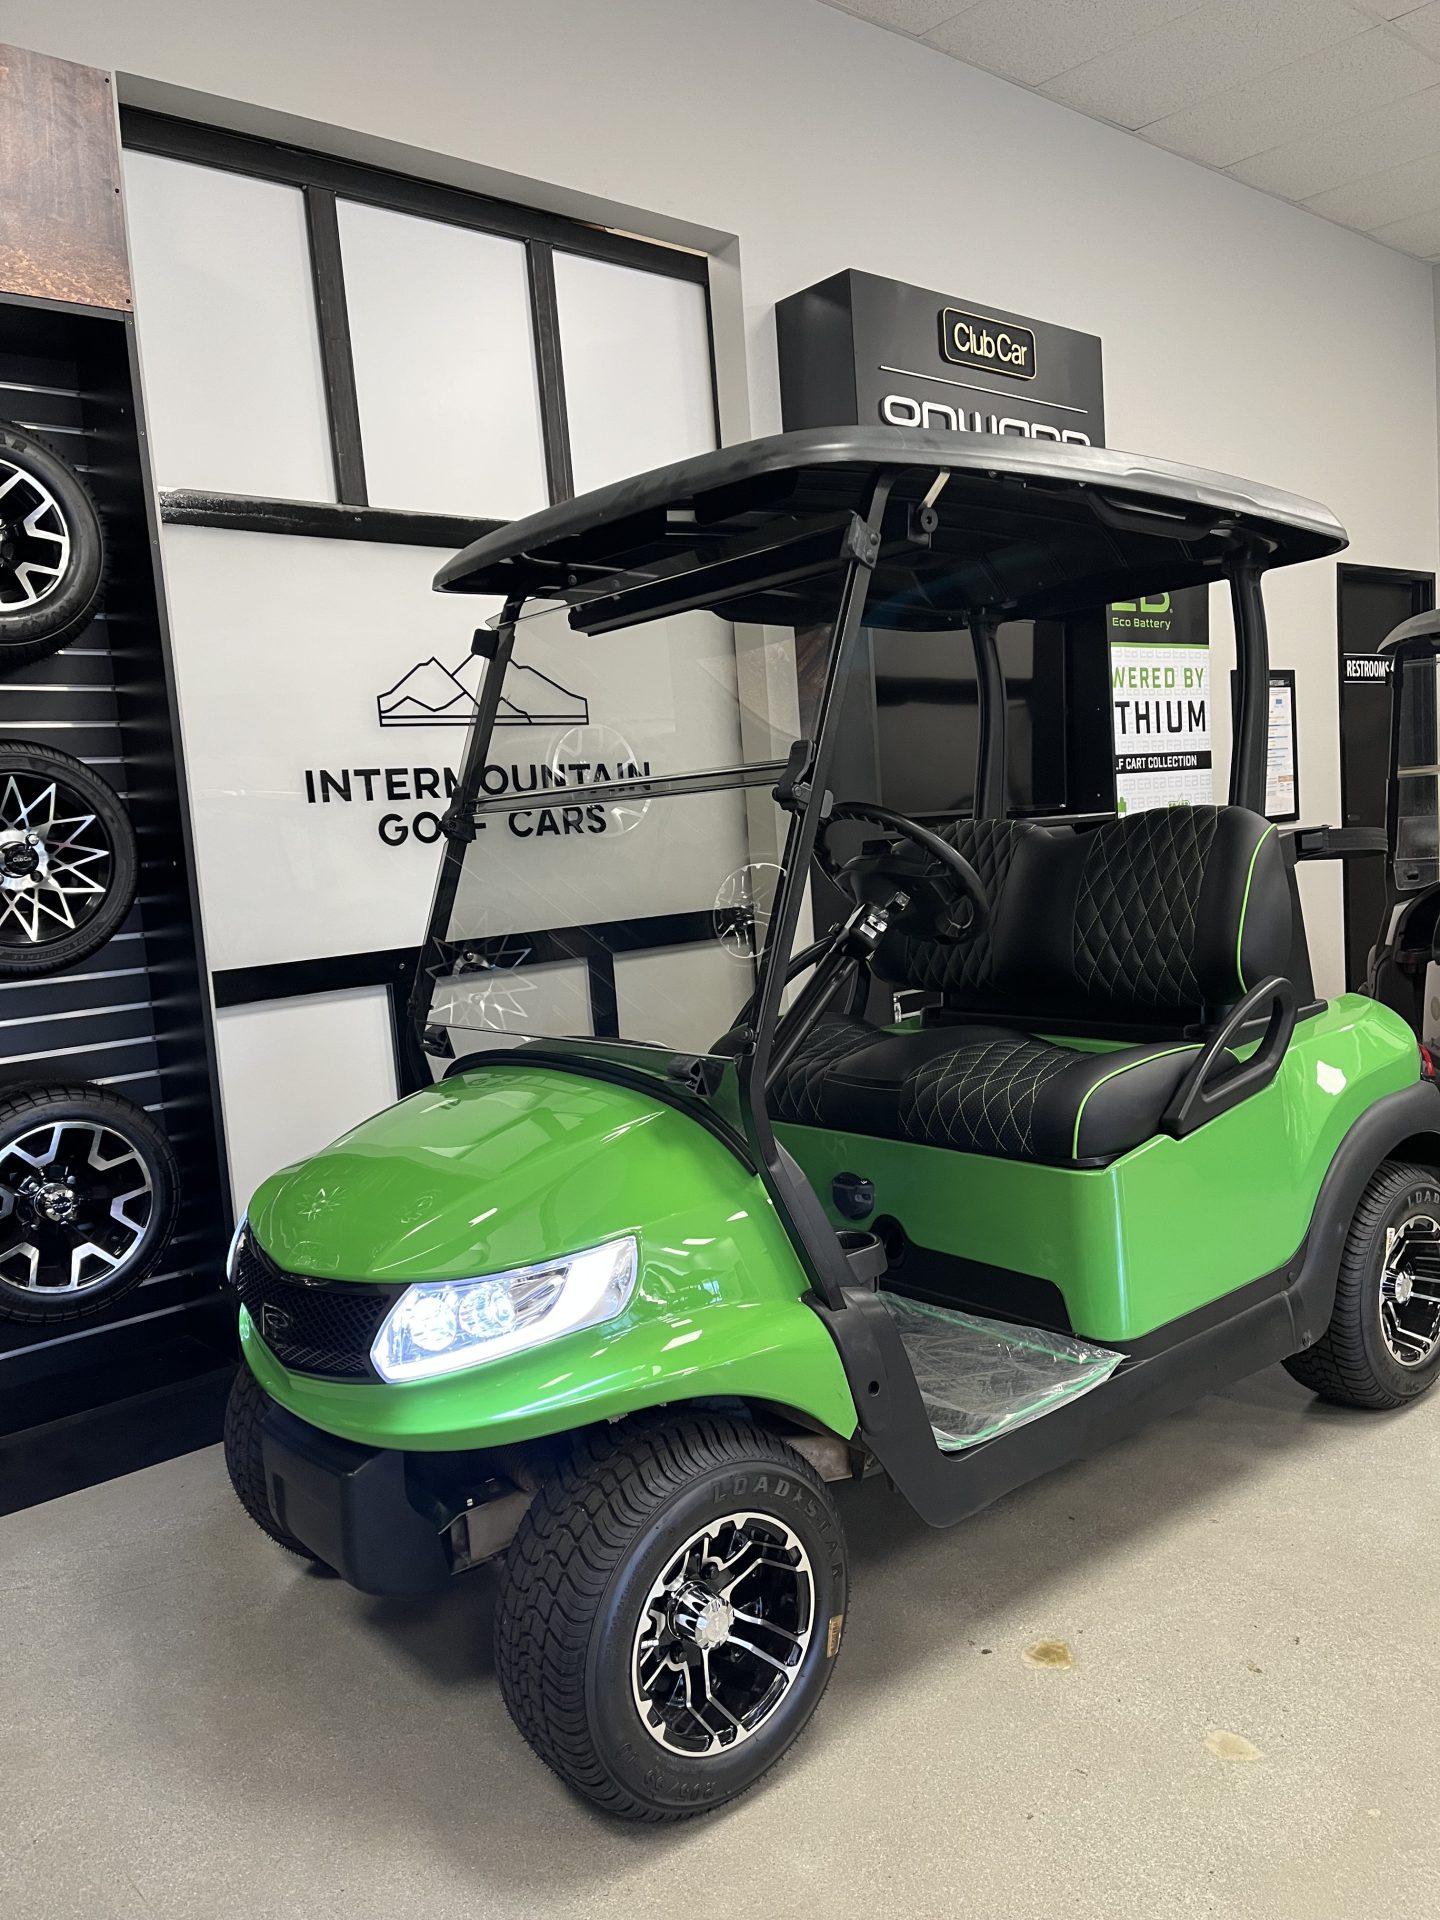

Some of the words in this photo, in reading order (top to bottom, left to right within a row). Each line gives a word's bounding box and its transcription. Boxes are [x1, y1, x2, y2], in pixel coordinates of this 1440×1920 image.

[954, 322, 995, 359] Club
[997, 333, 1027, 366] Car
[1112, 617, 1132, 627] Eco
[1134, 618, 1171, 630] Battery
[1184, 668, 1204, 688] BY
[1114, 700, 1206, 735] THIUM
[1126, 758, 1147, 770] CART
[1148, 754, 1198, 769] COLLECTION
[378, 811, 487, 847] GO
[508, 804, 608, 838] CARS
[713, 1476, 791, 1504] LOAD
